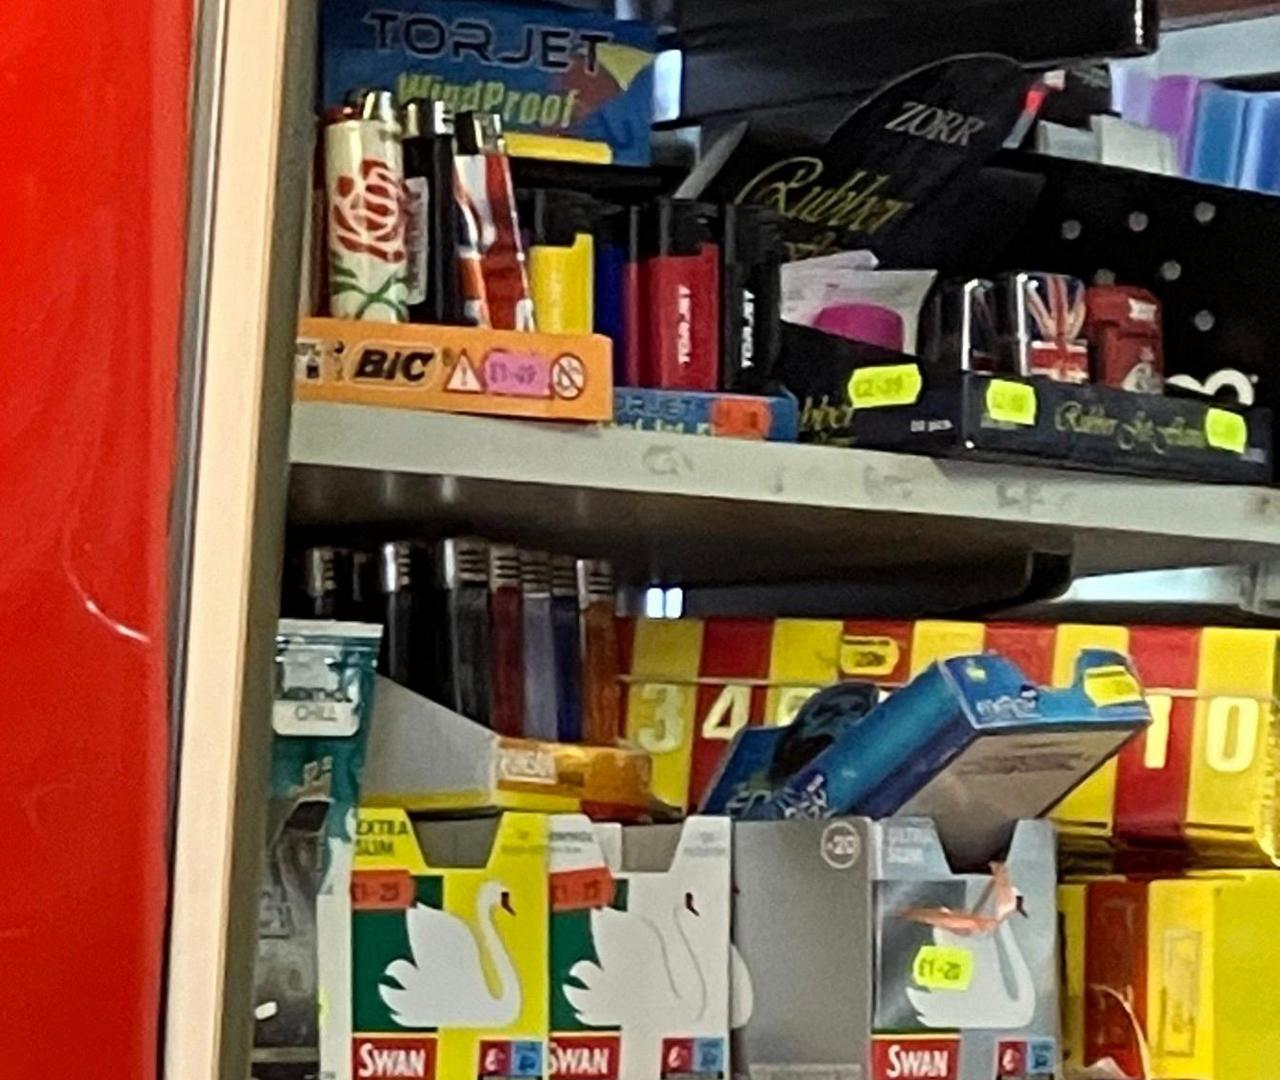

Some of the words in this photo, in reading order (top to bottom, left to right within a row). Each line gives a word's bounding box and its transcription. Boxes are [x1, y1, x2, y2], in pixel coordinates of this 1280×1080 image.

[367, 11, 614, 75] TORJET
[397, 71, 581, 129] WindProof
[884, 100, 987, 147] ZORR
[639, 684, 685, 754] 3
[354, 839, 393, 856] SLIM
[356, 819, 409, 836] EXTRA
[358, 1042, 426, 1078] SWAN
[886, 1044, 949, 1079] SWAN
